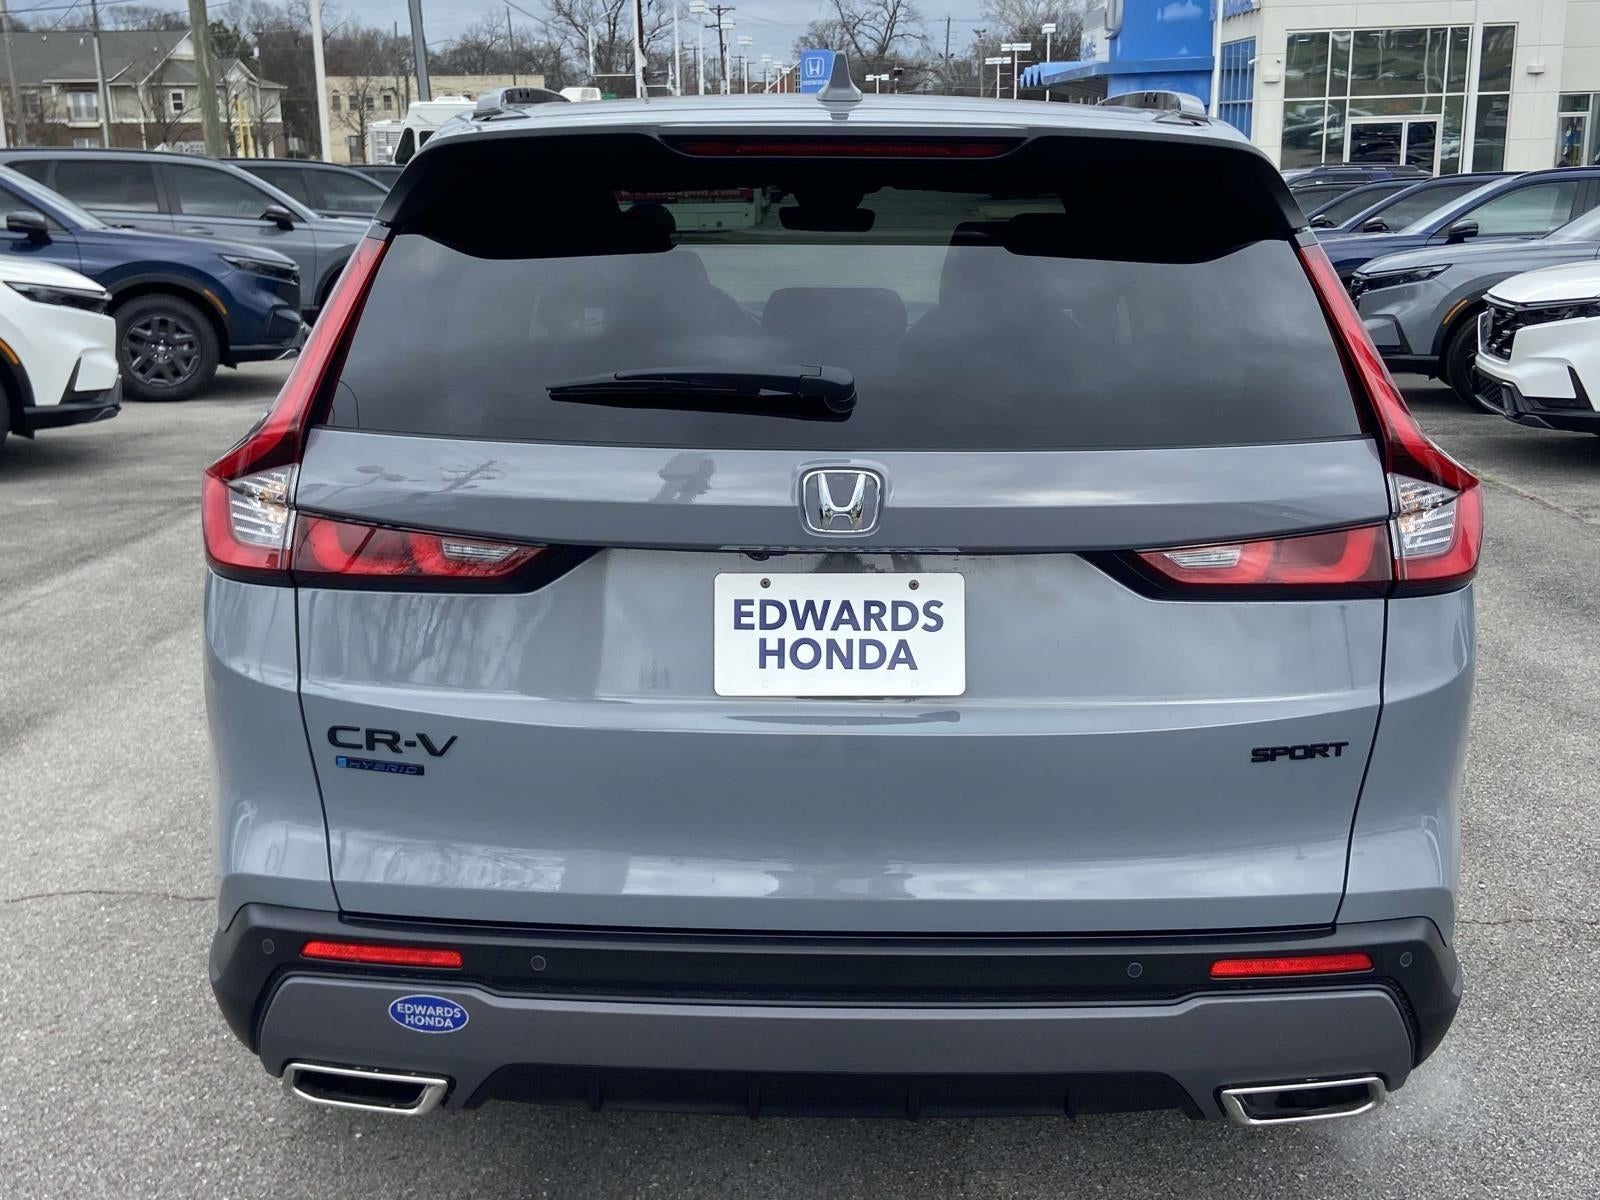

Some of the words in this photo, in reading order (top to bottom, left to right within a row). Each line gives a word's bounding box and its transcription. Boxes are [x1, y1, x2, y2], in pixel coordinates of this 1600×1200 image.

[733, 599, 944, 632] EDWARDS
[758, 637, 918, 670] HONDA
[327, 725, 458, 757] CR-V
[1250, 741, 1349, 762] SPORT
[348, 760, 418, 774] HYBRID
[396, 1003, 461, 1018] EDWARDS
[405, 1014, 454, 1028] HONDA
